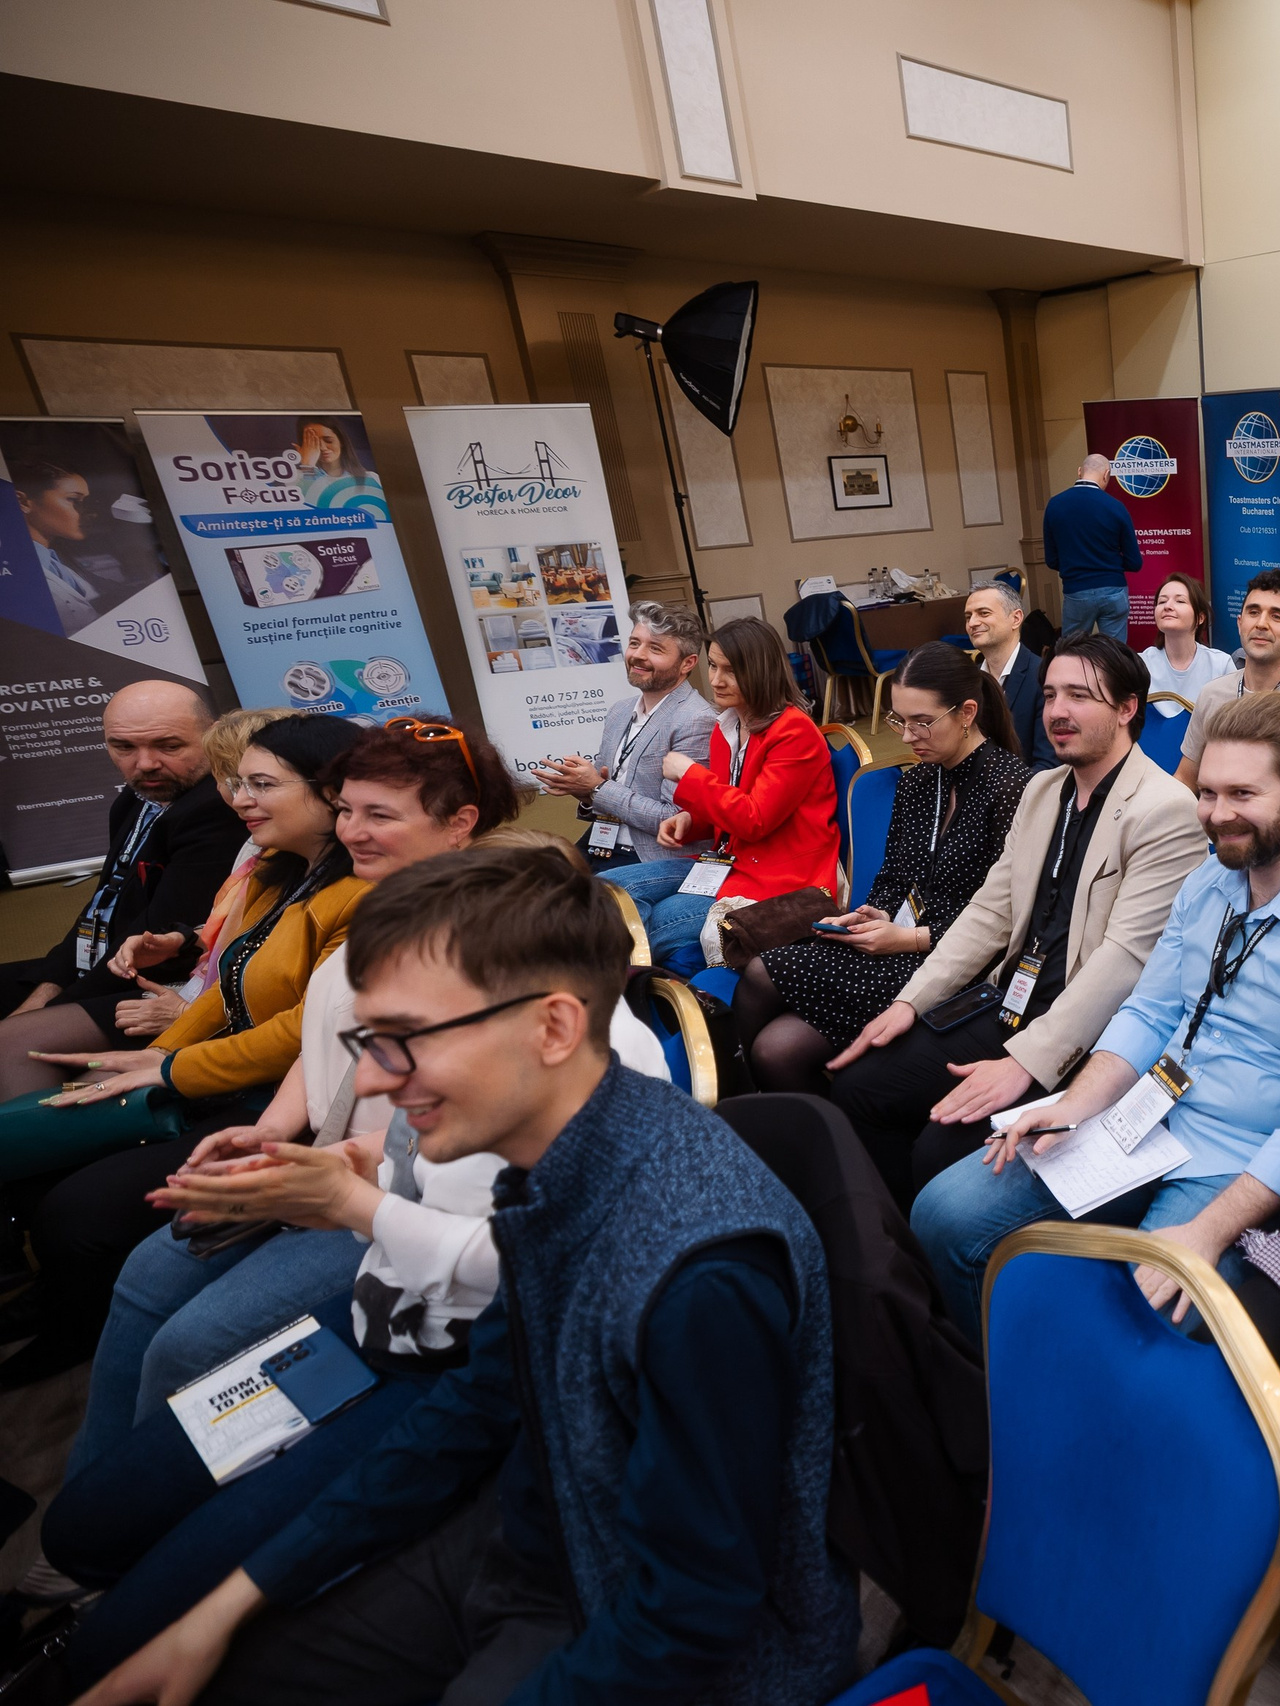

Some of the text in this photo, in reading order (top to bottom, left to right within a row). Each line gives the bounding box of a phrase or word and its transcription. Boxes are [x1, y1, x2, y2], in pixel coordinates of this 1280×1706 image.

[1110, 460, 1174, 469] TOASTMASTERS
[446, 482, 582, 510] Bosfor Decor
[1228, 496, 1271, 504] Toastmasters
[477, 508, 510, 516] HORECA
[1242, 506, 1274, 516] Bucharest
[286, 516, 301, 527] să
[1240, 526, 1251, 534] Club
[1234, 558, 1260, 568] Bucharest,
[243, 618, 288, 633] Special
[292, 614, 346, 629] formulat
[350, 609, 388, 623] pentru
[247, 630, 293, 644] susține
[349, 620, 402, 634] cognitive
[88, 676, 104, 688] &
[526, 688, 604, 704] 0740 757 280
[2, 716, 102, 732] Formule inovative
[544, 718, 574, 728] Bosfor
[5, 733, 38, 742] Peste
[40, 730, 60, 738] 300
[8, 740, 61, 750] in-house
[208, 1376, 255, 1406] FROM
[214, 1398, 234, 1413] TO
